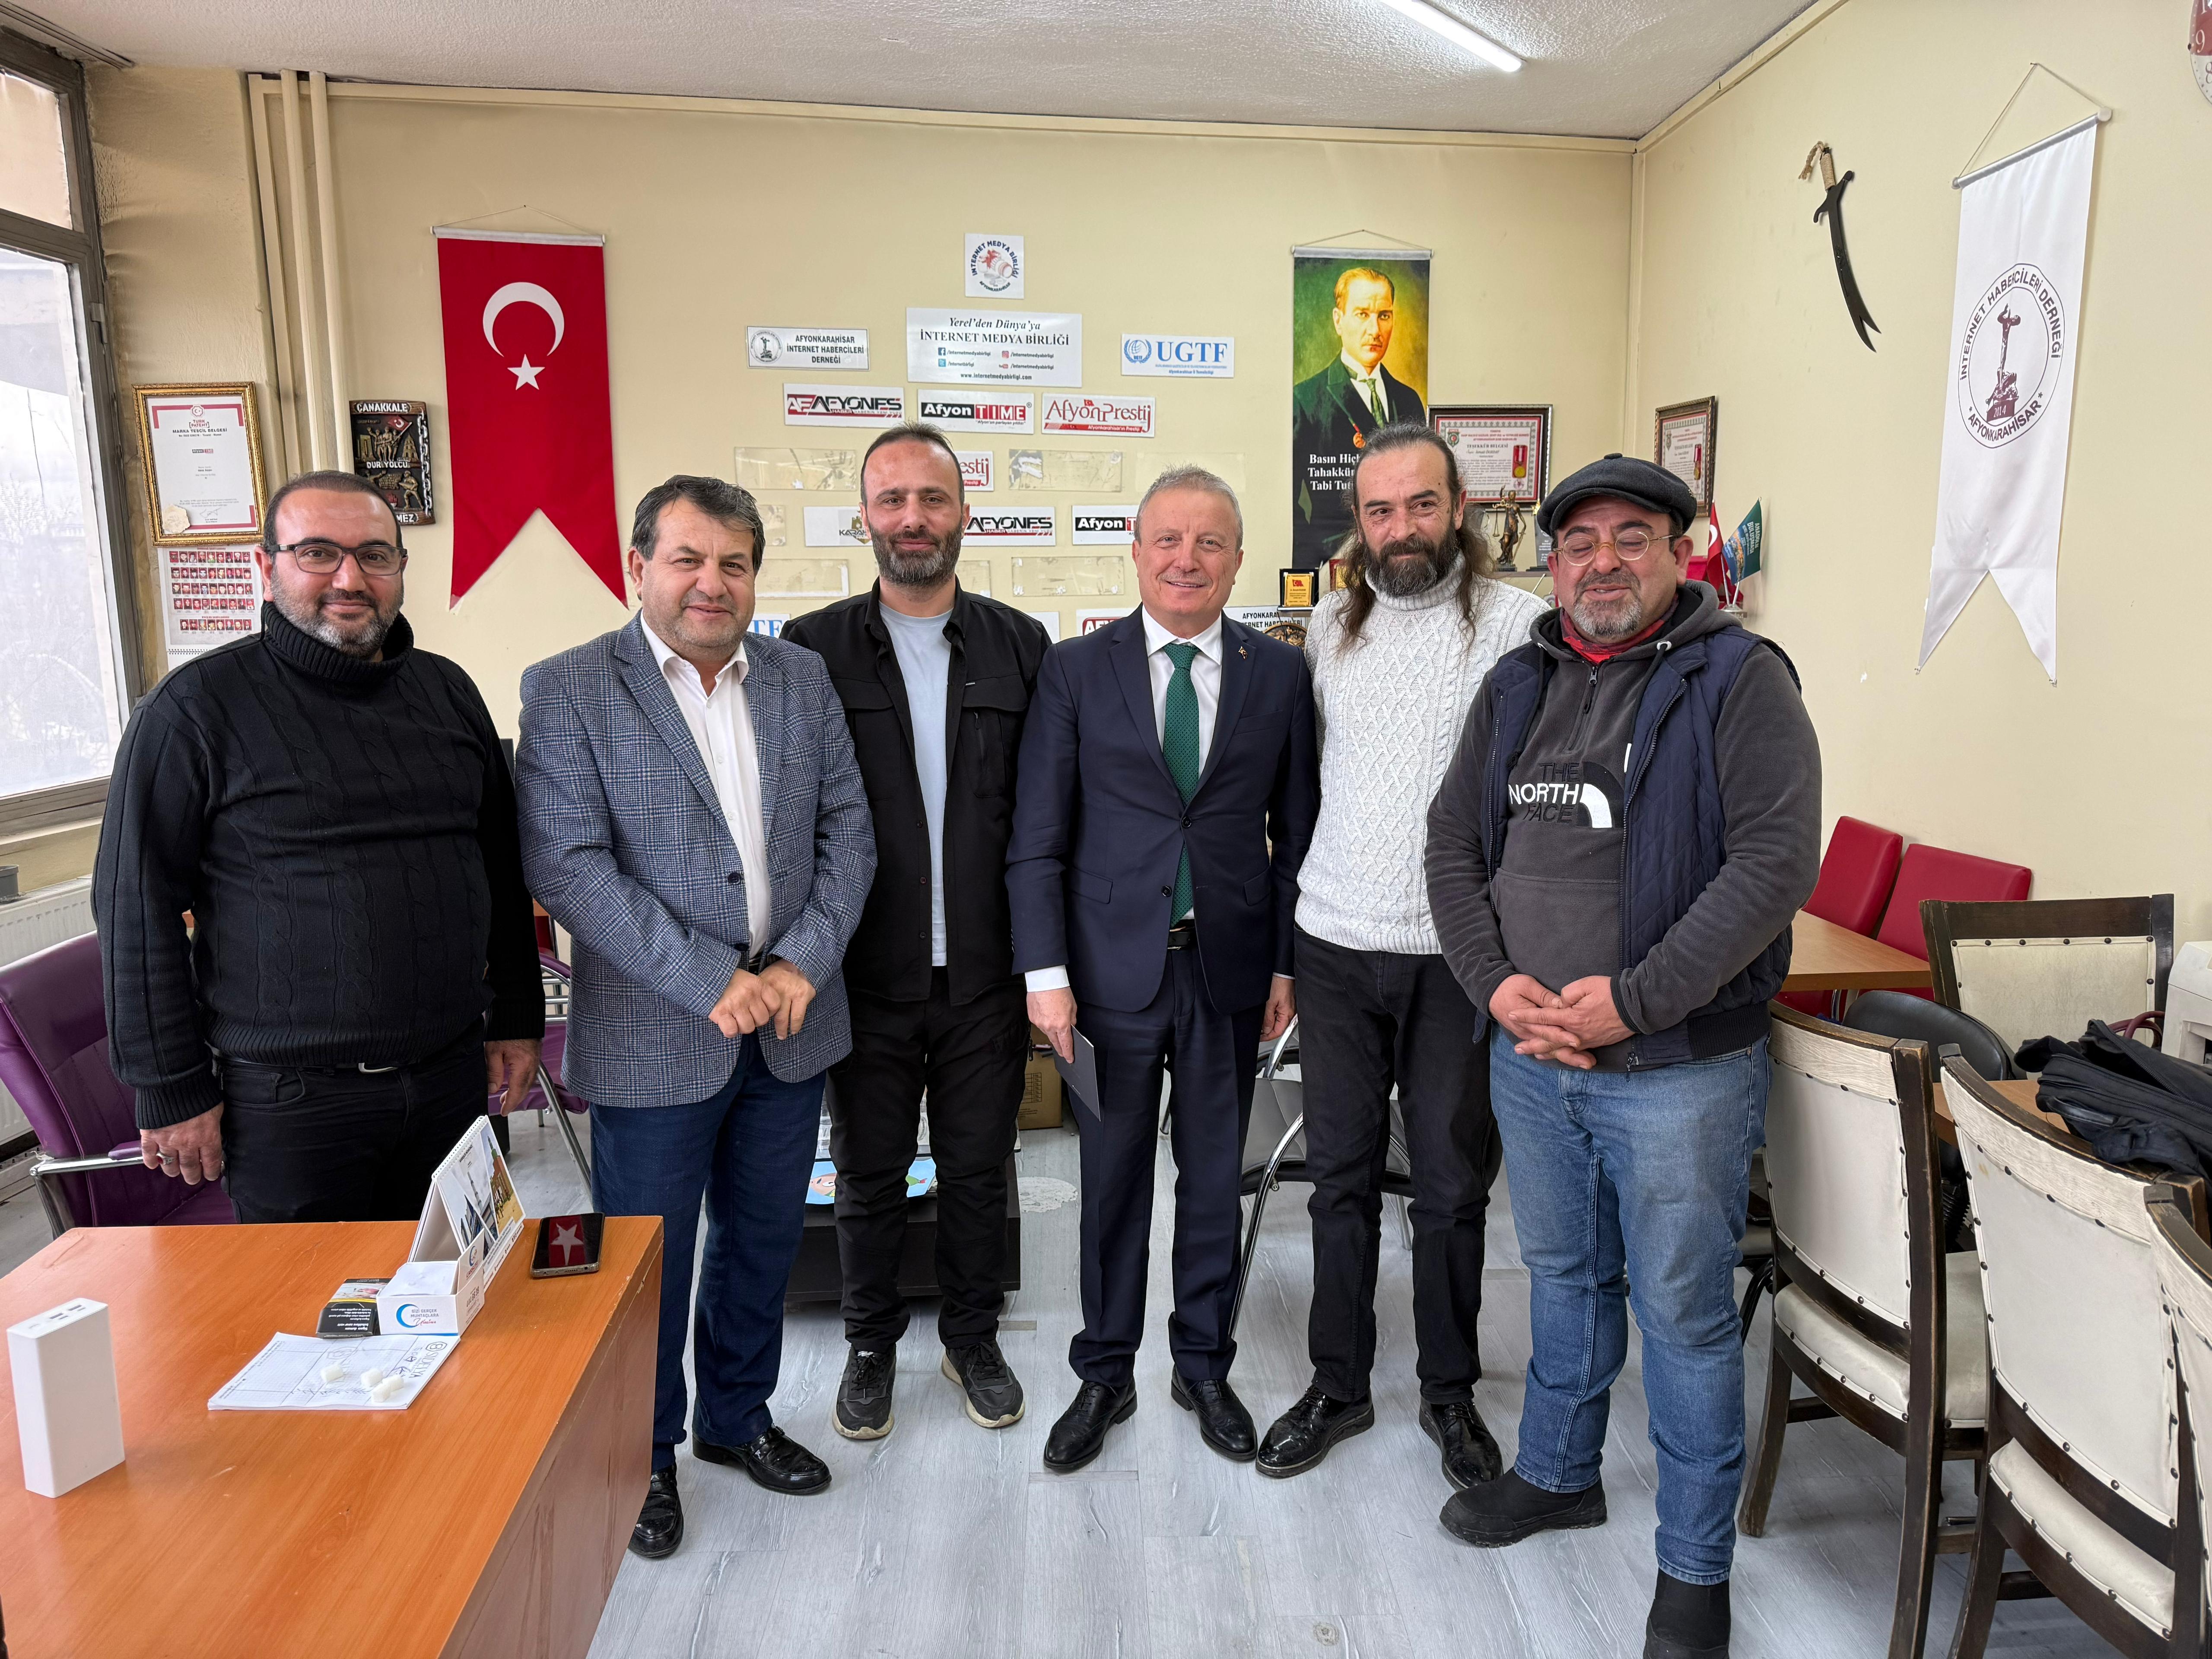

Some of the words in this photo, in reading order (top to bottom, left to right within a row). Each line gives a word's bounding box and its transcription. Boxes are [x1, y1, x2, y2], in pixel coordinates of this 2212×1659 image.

[2196, 29, 2205, 53] 9
[987, 241, 1010, 253] MEDYA
[1960, 303, 1986, 380] İNTERNET
[1988, 268, 2044, 306] HABERCİLERİ
[2039, 289, 2062, 358] DERNEĞİ
[795, 334, 855, 343] AFYONKARAHİSAR
[920, 329, 979, 342] İNTERNET
[982, 334, 1023, 344] MEDYA
[1026, 333, 1069, 346] BİRLİĞİ
[787, 343, 819, 353] İNTERNET
[821, 345, 864, 354] HABERCİLERİ
[1156, 341, 1227, 362] UGTF
[812, 355, 841, 363] DERNEĞİ
[924, 404, 972, 417] Afyon
[976, 405, 1025, 420] TIME
[1993, 405, 2007, 418] 2014
[1968, 400, 2042, 442] AFYONKARAHİSAR
[1309, 454, 1336, 464] Basın
[1310, 480, 1332, 490] Tabi
[396, 514, 414, 522] MEZ
[1078, 518, 1123, 531] Afyon
[752, 620, 782, 637] TF
[1539, 762, 1580, 782] THE
[1508, 783, 1580, 805] NORTH
[1523, 803, 1576, 823] FACE
